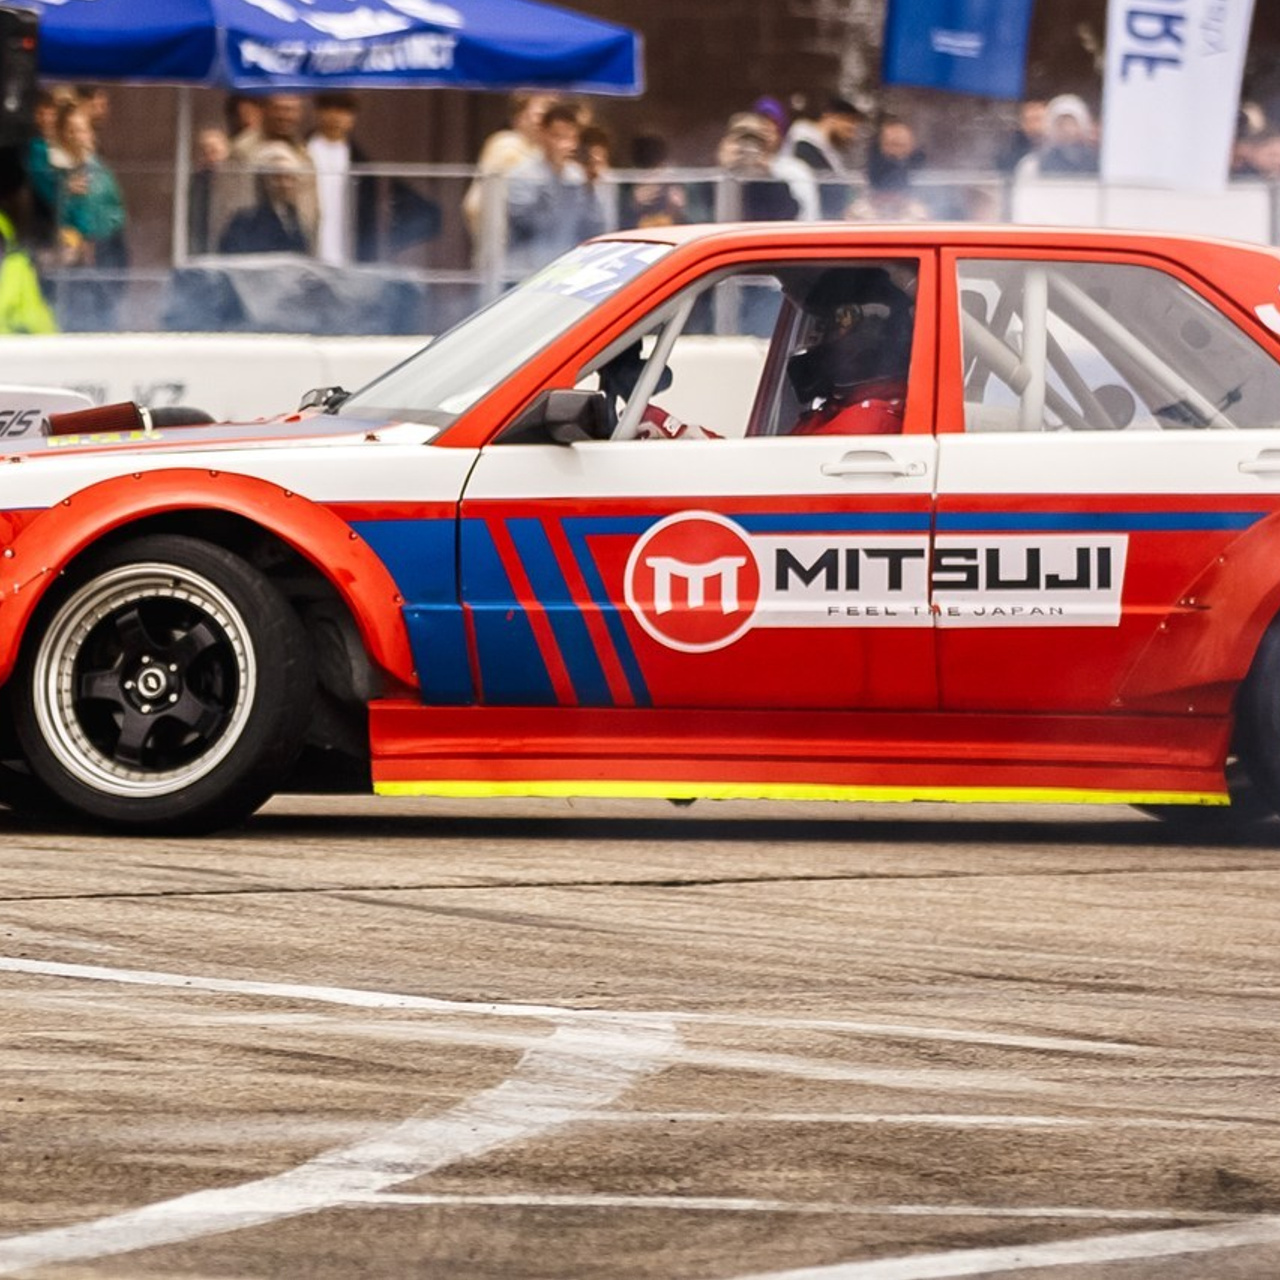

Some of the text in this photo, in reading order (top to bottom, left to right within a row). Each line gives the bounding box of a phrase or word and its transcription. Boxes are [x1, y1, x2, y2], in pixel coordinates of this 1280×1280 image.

[774, 547, 1112, 592] MITSUJI
[827, 605, 1064, 617] FEEL THE JAPAN
